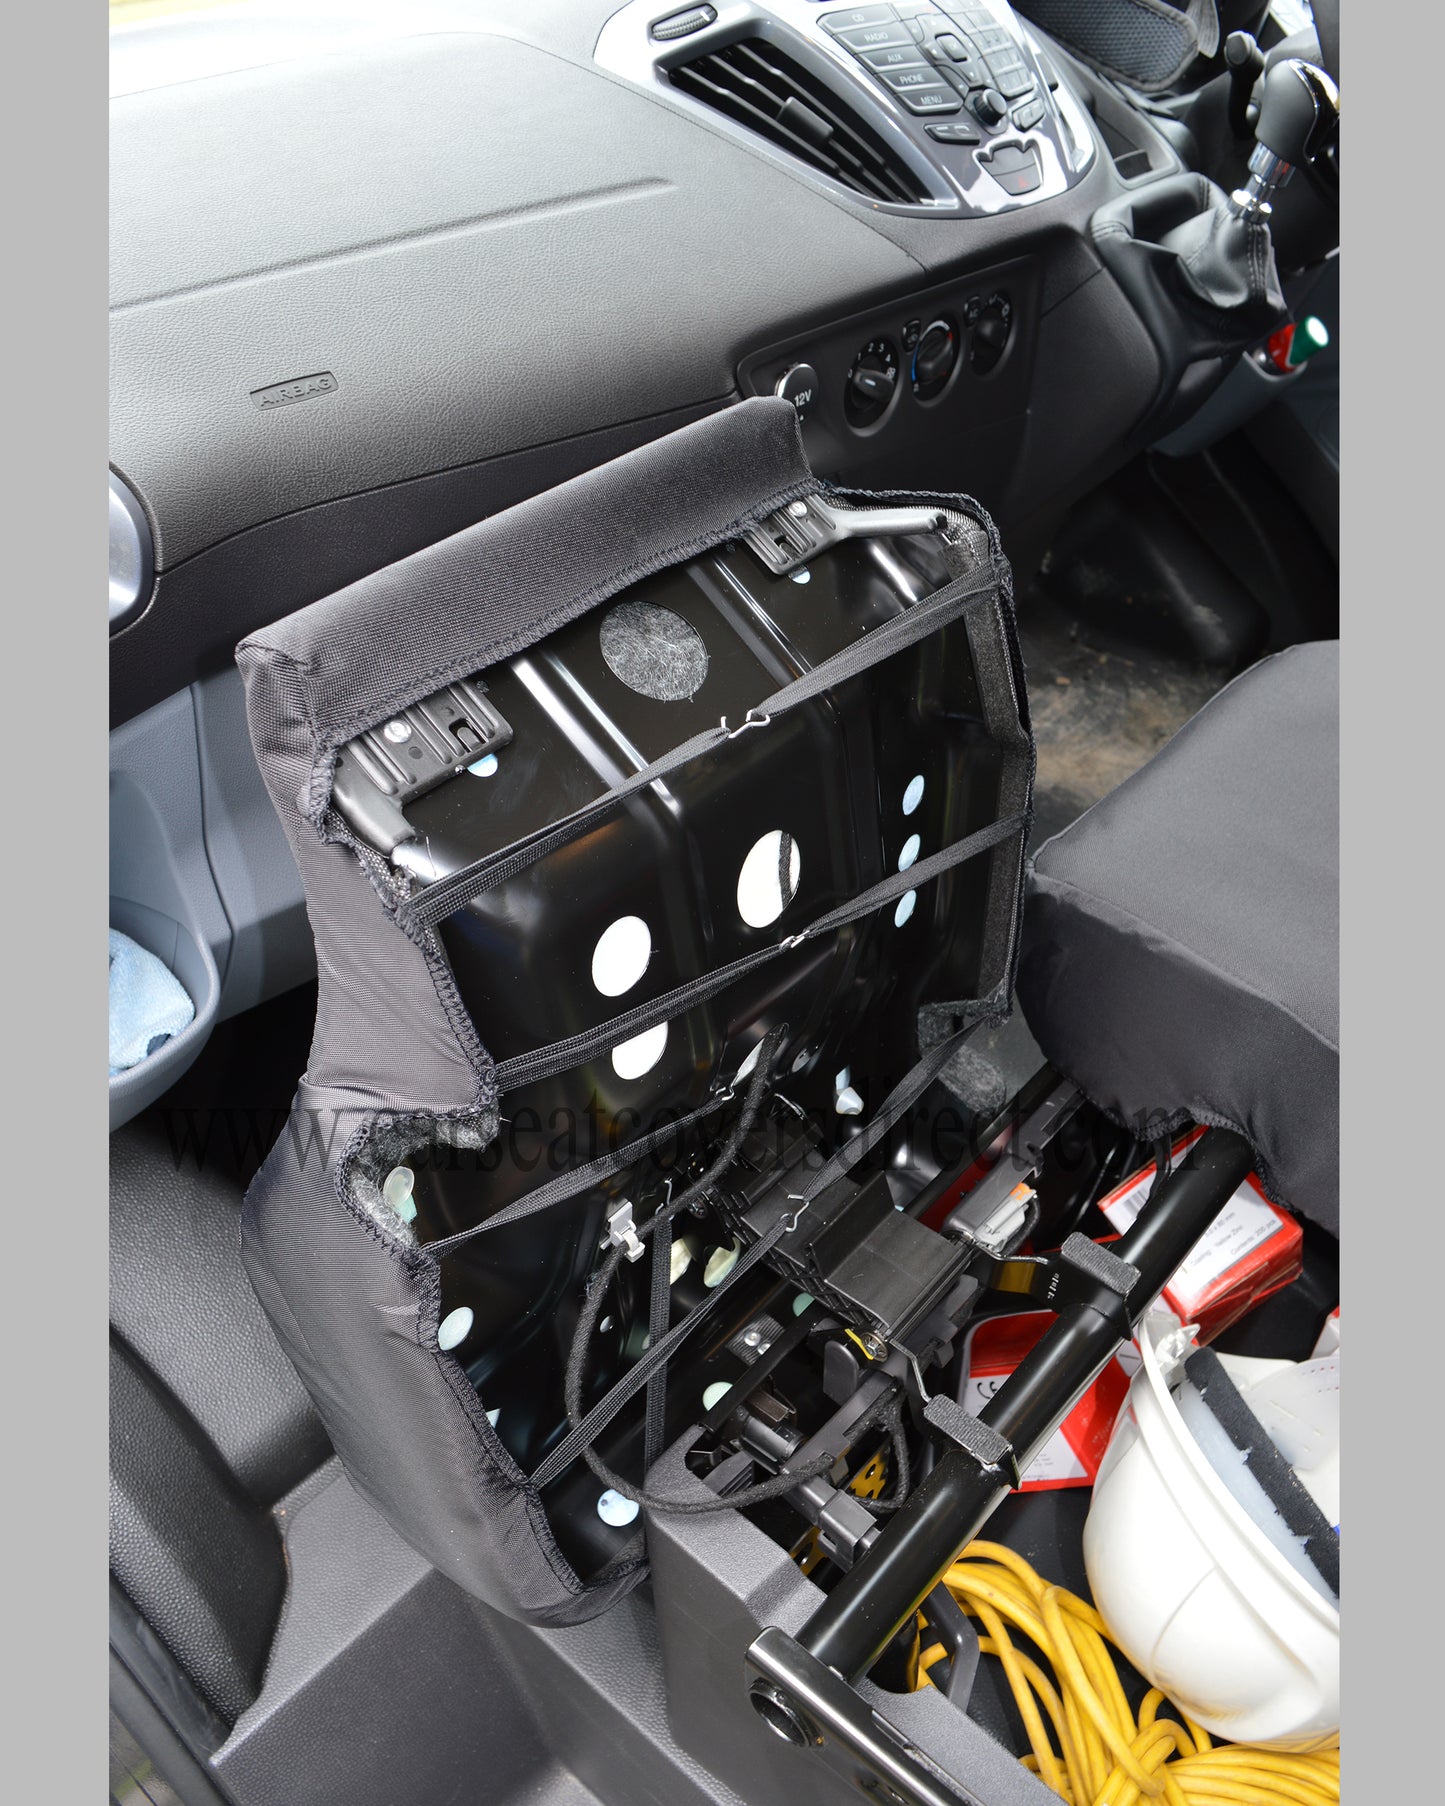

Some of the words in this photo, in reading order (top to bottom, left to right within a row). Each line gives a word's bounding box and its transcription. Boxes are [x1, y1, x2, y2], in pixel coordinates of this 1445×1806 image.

[864, 32, 888, 42] RADIO
[888, 54, 903, 63] AUX
[900, 74, 925, 84] PHONE
[921, 96, 942, 105] MENU
[868, 342, 874, 353] 2
[878, 342, 885, 353] 3
[885, 353, 892, 362] 4
[794, 388, 812, 408] 12V
